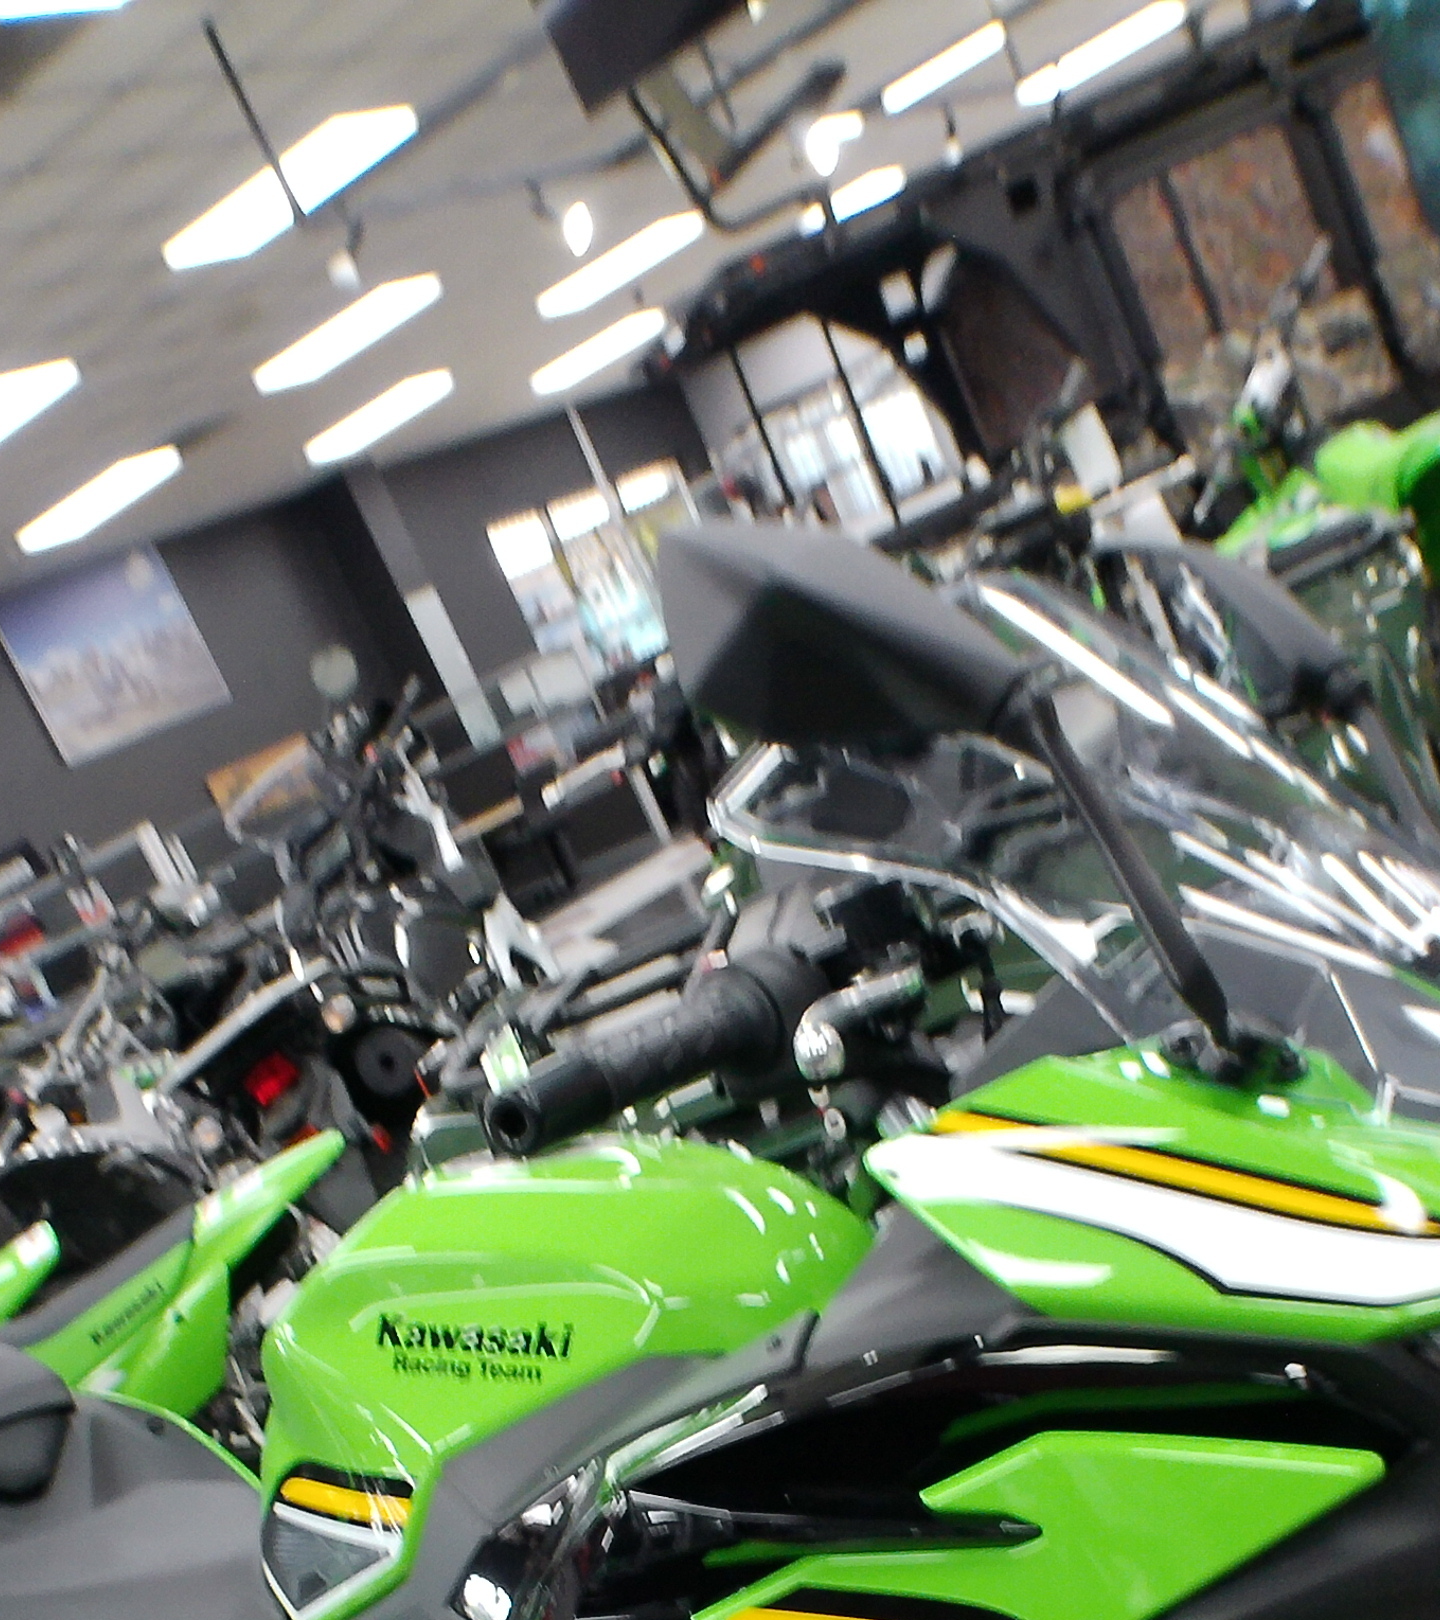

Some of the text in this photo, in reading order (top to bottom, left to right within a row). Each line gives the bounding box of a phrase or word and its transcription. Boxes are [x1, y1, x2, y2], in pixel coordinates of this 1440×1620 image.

[376, 1311, 575, 1360] Kawasaki
[391, 1349, 544, 1384] Racing Team
